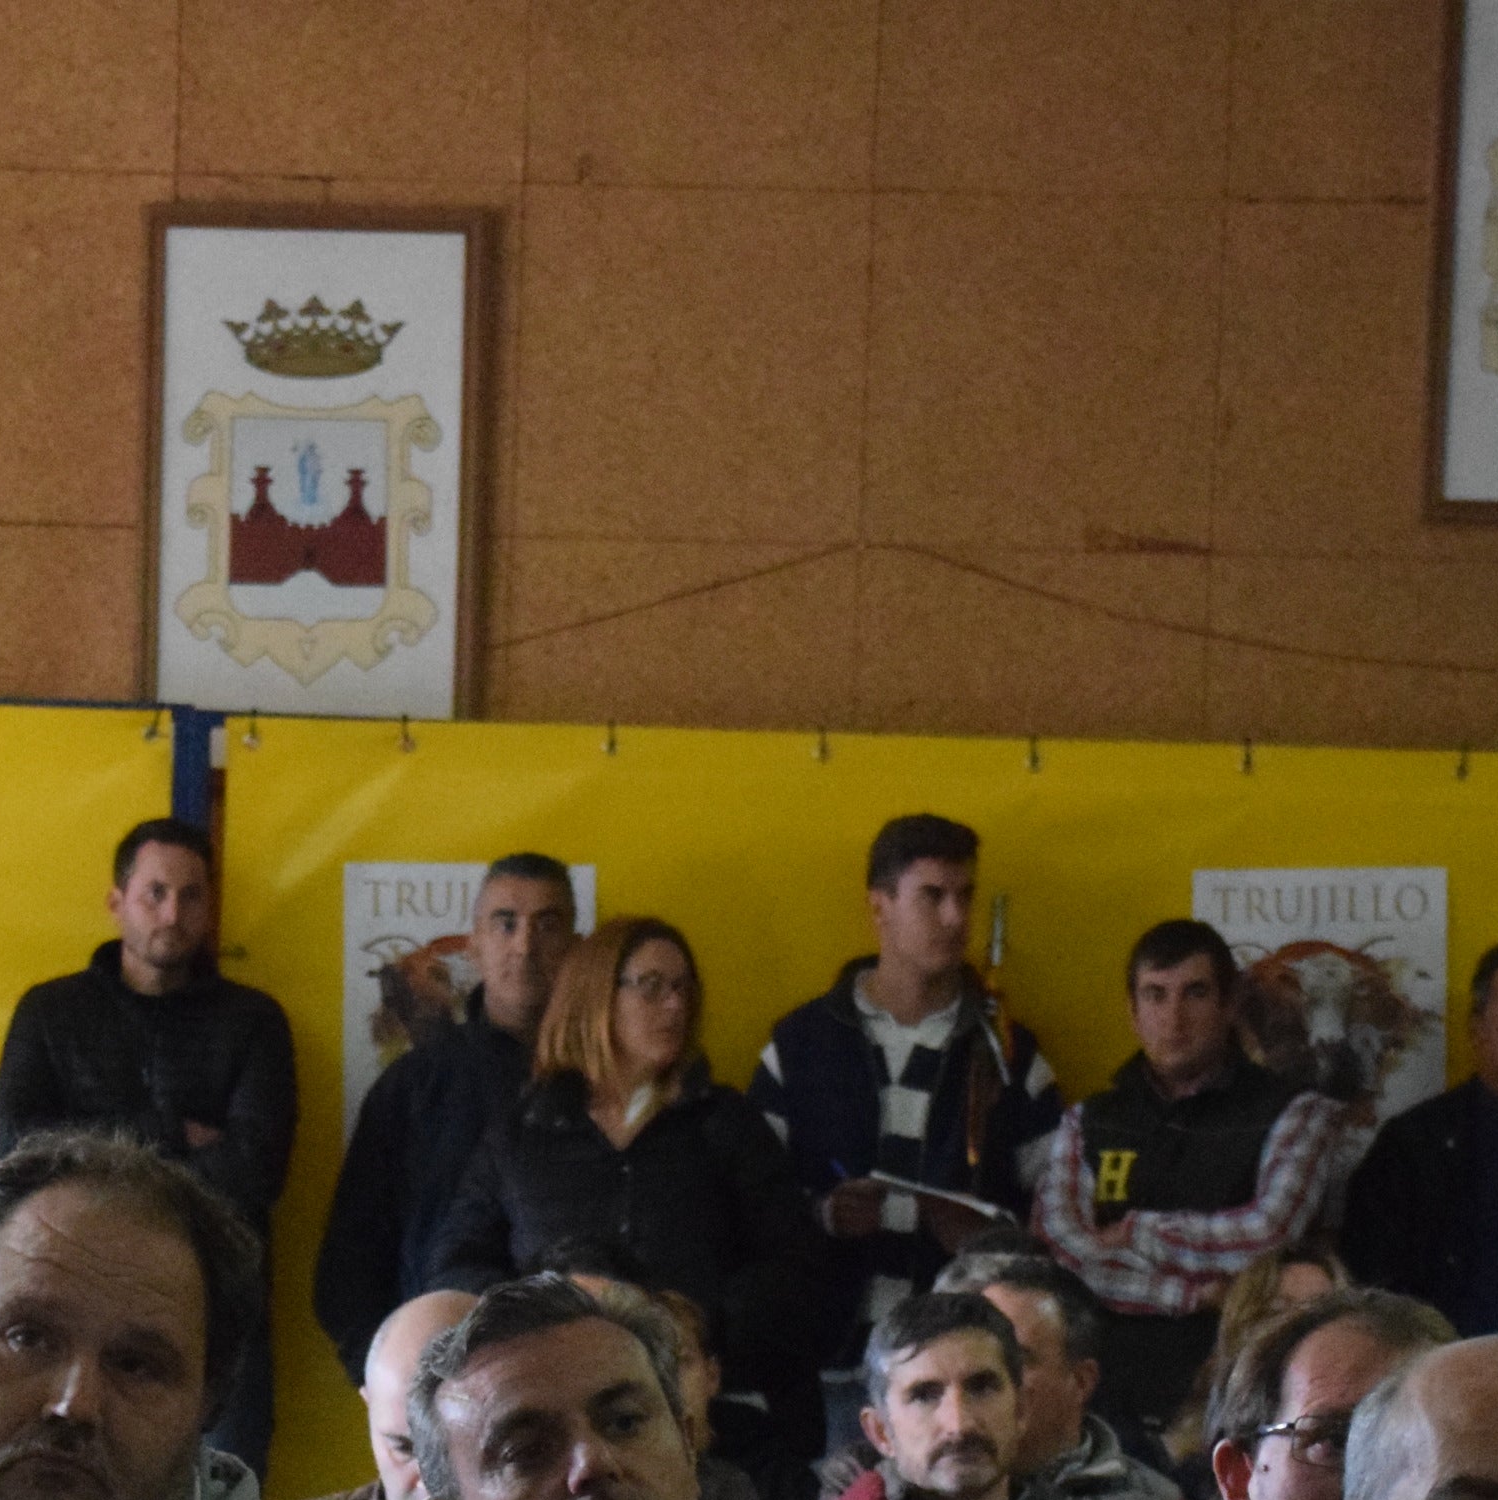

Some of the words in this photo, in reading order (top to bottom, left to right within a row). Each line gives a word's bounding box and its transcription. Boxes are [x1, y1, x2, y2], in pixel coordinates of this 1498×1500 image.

[363, 878, 469, 926] TRUJ
[1212, 882, 1430, 928] TRUJILLO
[1096, 1149, 1139, 1201] H
